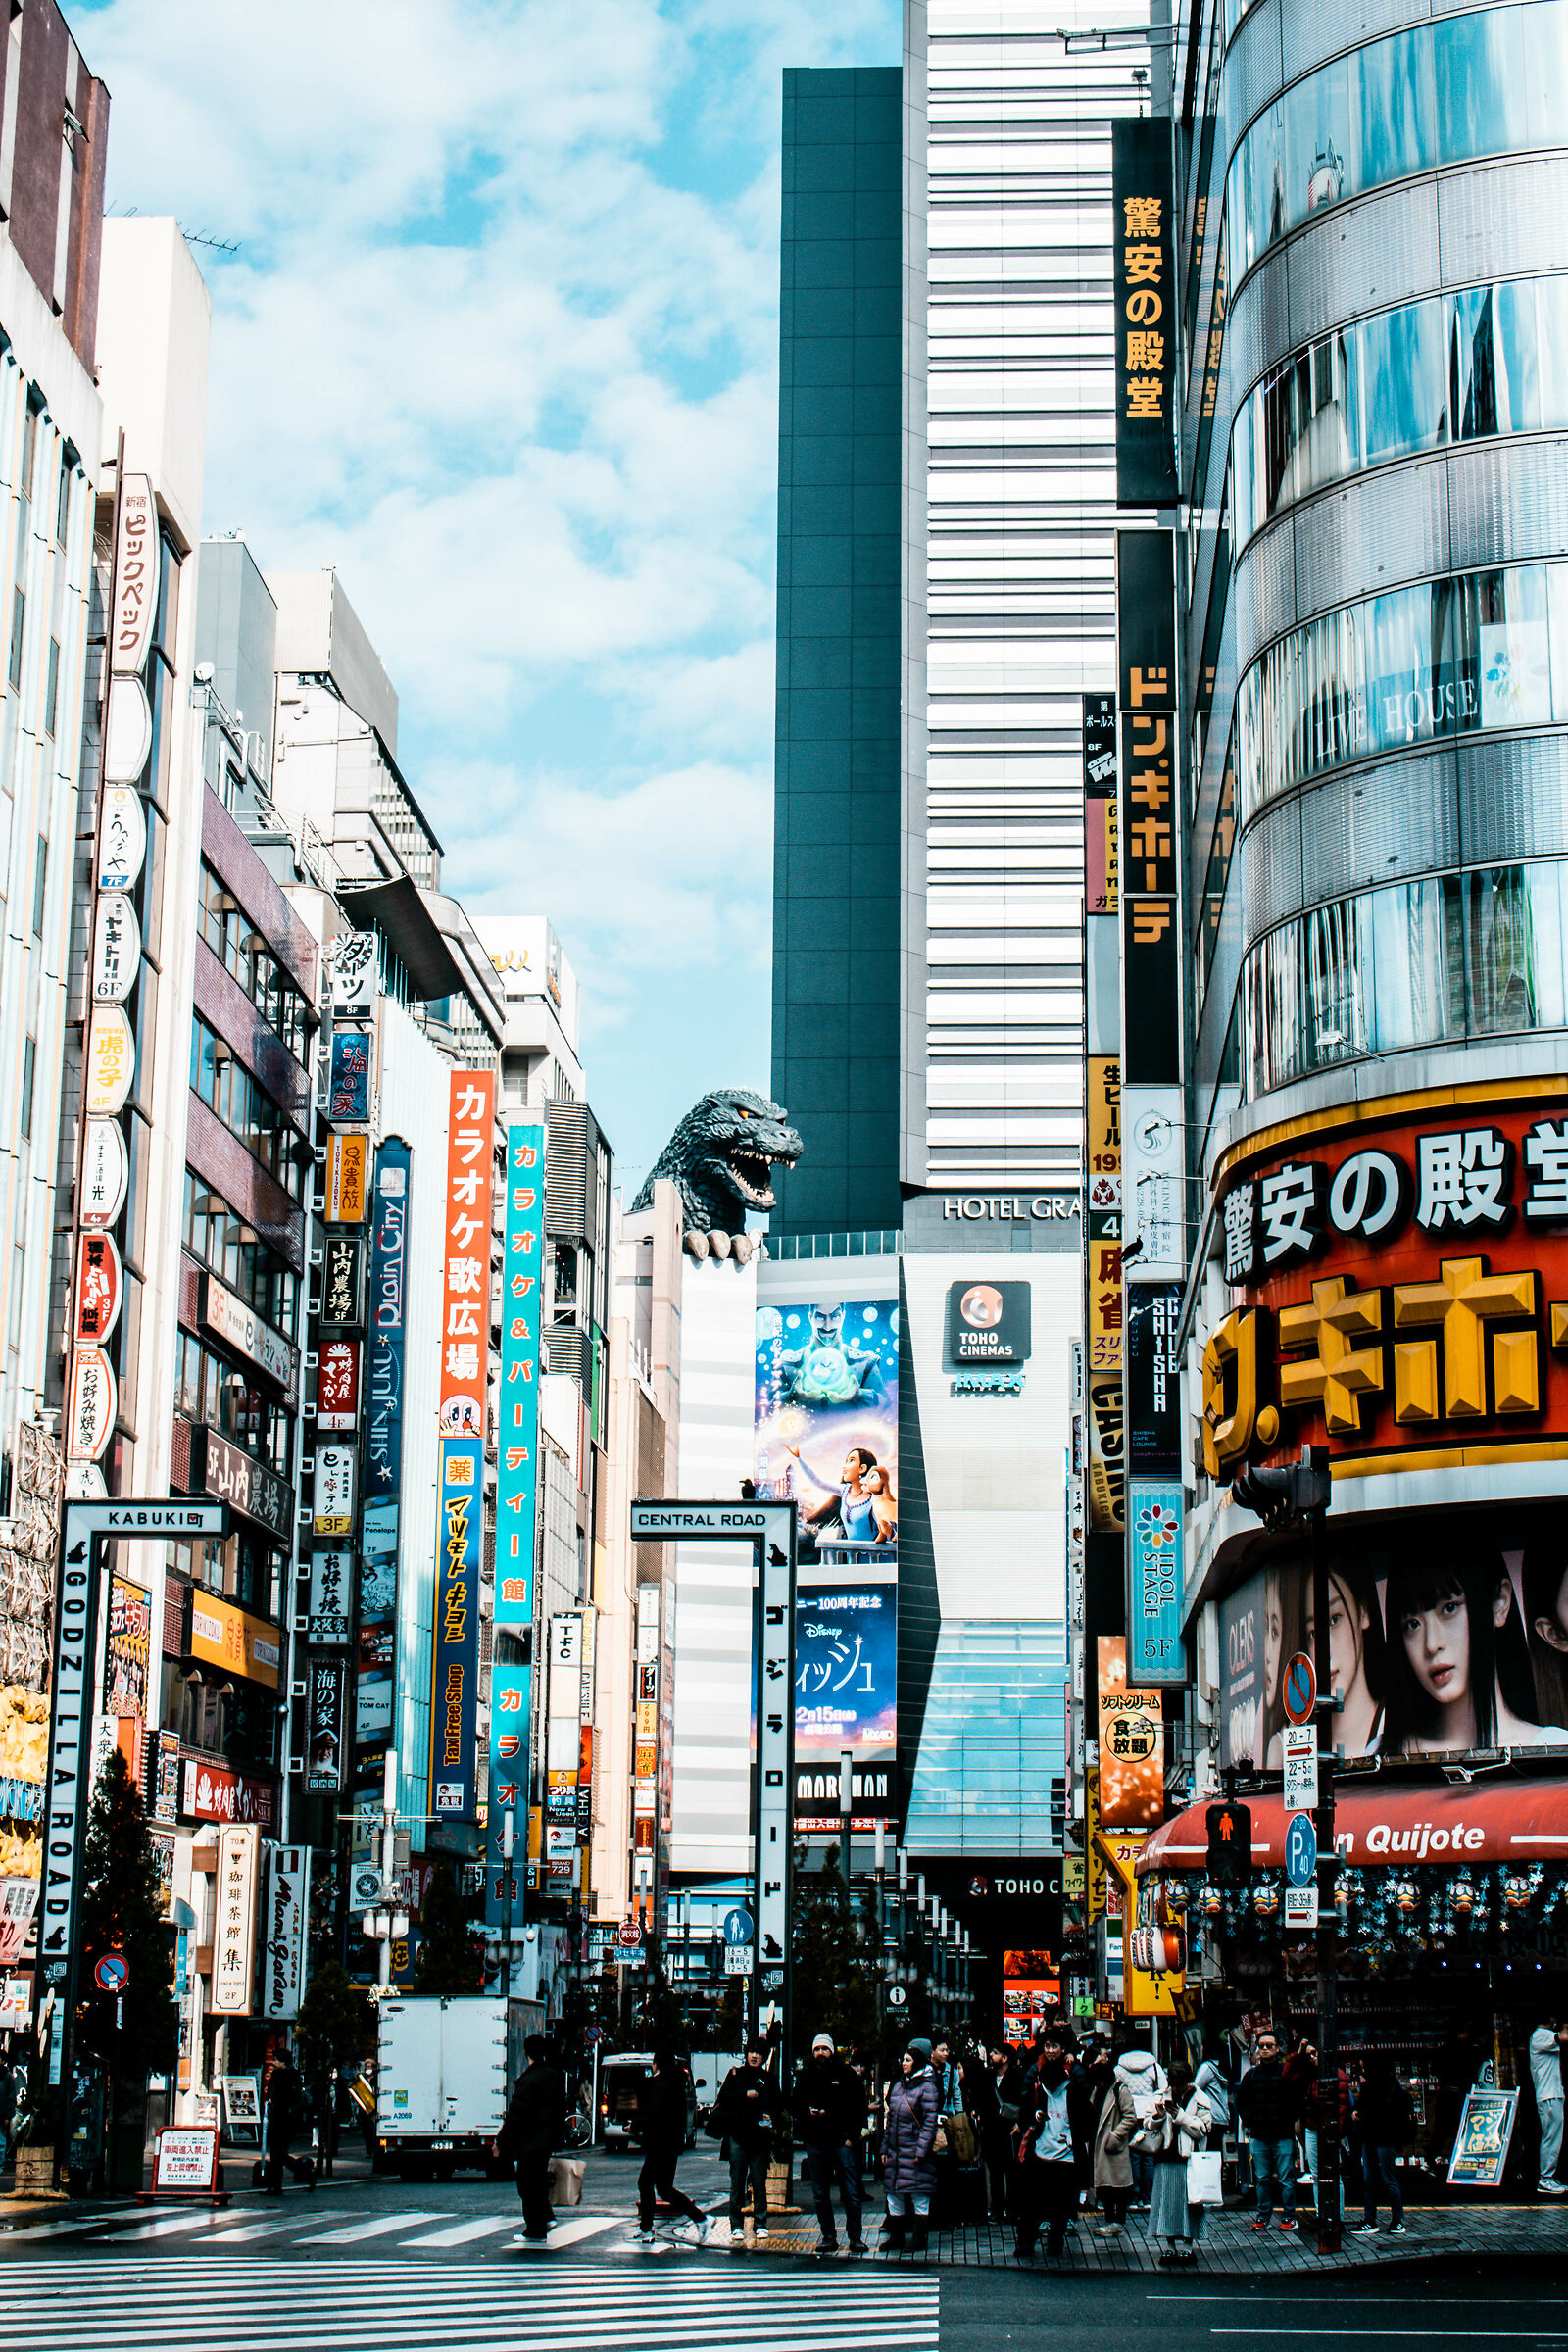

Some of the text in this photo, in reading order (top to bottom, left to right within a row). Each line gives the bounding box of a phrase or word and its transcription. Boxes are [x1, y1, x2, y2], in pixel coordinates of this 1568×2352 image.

[1123, 197, 1164, 417] 驚安の殿堂
[125, 496, 147, 508] 新宿
[119, 514, 146, 650] ピックペック
[1382, 678, 1479, 733] HOUSE
[1130, 667, 1171, 943] ドン・キホーテ
[106, 876, 123, 886] 7F
[342, 937, 370, 1001] ダーツ
[97, 981, 122, 997] 6F
[345, 1005, 359, 1015] 8F
[95, 1035, 124, 1088] 虎の子
[331, 1048, 368, 1116] 海の家
[92, 1097, 111, 1106] 4F
[342, 1145, 361, 1210] 鳥貴族
[1092, 1153, 1122, 1172] 19
[92, 1185, 105, 1200] 光
[943, 1197, 1027, 1219] HOTEL
[1223, 1118, 1568, 1283] 驚安の殿堂
[445, 1083, 488, 1381] カラオケ歌広場
[328, 1241, 354, 1312] 山内農場
[101, 1298, 111, 1322] 3F
[212, 1287, 226, 1324] 3F
[334, 1311, 347, 1321] 5F
[959, 1332, 999, 1346] TOHO
[959, 1345, 1013, 1357] CINEMAS
[1152, 1297, 1167, 1413] SHISHA
[955, 1372, 1026, 1390] IMAX
[79, 1367, 98, 1446] お好み焼き
[327, 1414, 346, 1429] 4F
[208, 1445, 220, 1478] 5F
[449, 1458, 471, 1483] 薬
[218, 1446, 279, 1529] 山内農場
[322, 1517, 344, 1532] 3F
[638, 1513, 766, 1526] CENTRAL ROAD
[319, 1553, 342, 1616] お好み焼
[1143, 1552, 1158, 1618] STAGE
[1158, 1552, 1174, 1606] IDOL
[1144, 1637, 1174, 1659] 5F
[1229, 1608, 1255, 1677] OLENS
[795, 1634, 876, 1692] ィッシュ
[316, 1668, 337, 1727] 海の家
[444, 1664, 465, 1701] Shop
[444, 1701, 462, 1737] Free
[1101, 1694, 1160, 1710] ソフトクリーム
[47, 1570, 87, 1916] GODZILLA ROAD
[444, 1738, 461, 1767] Tax
[638, 1747, 656, 1773] 麻雀
[765, 1604, 788, 1898] ゴジラロード
[1113, 1738, 1149, 1755] 放題
[440, 1795, 461, 1806] 免税
[548, 1785, 577, 1796] つり具
[577, 1788, 590, 1837] AGEHA
[1291, 1830, 1303, 1876] P
[1333, 1823, 1486, 1859] n Quijote
[551, 1865, 571, 1875] 729
[1298, 1854, 1309, 1876] 40
[994, 1878, 1059, 1894] TOHO C
[267, 1875, 292, 2016] Miami Garden
[224, 1991, 237, 2000] 2F
